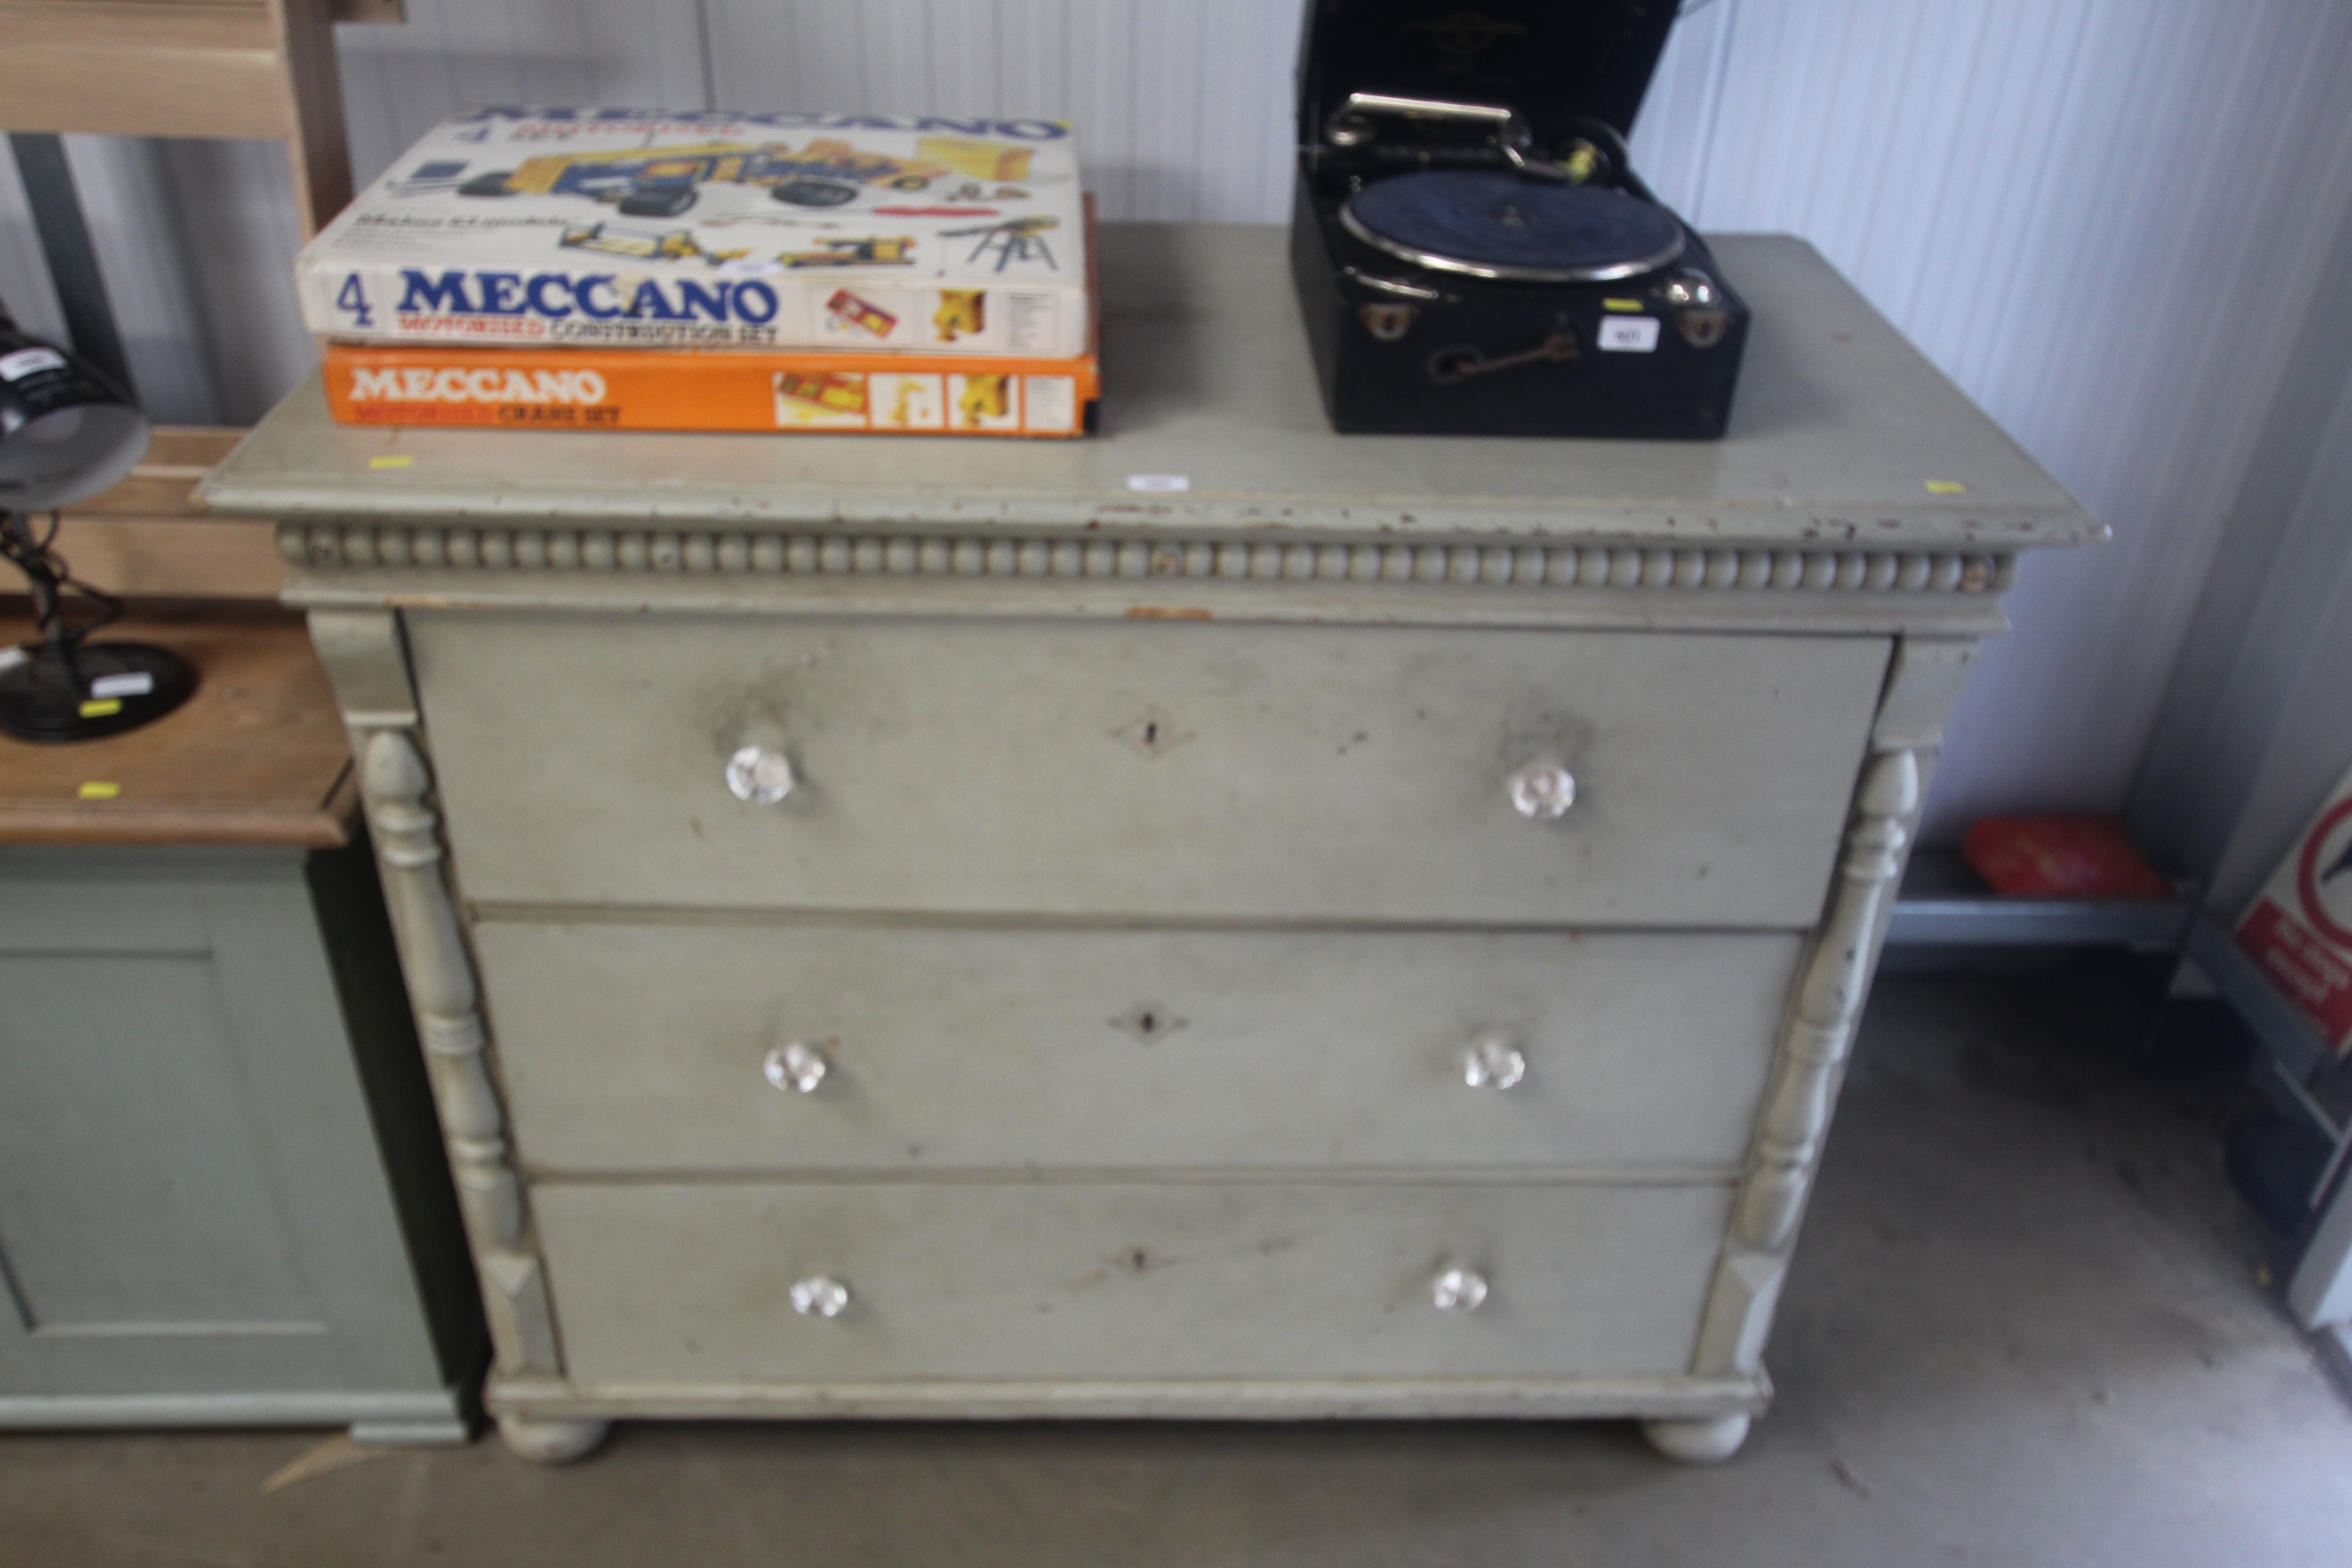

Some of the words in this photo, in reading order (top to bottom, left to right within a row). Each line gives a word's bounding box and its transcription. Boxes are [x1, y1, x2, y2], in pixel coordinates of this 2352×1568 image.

[336, 270, 375, 328] 4
[395, 270, 779, 323] MECCANO
[549, 319, 733, 342] CONSTRUCTION
[737, 325, 779, 343] SET
[348, 367, 608, 406] MECCANO
[498, 406, 576, 424] CRANE
[583, 407, 621, 424] SET
